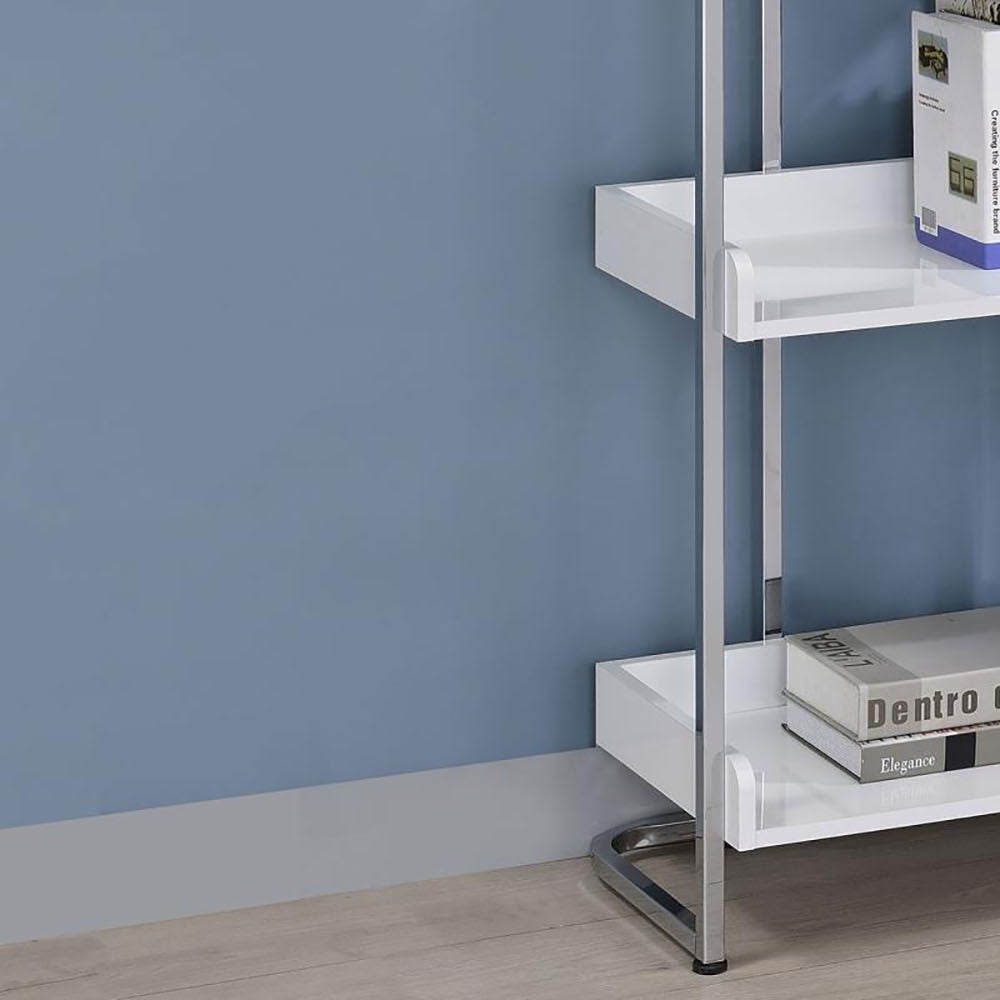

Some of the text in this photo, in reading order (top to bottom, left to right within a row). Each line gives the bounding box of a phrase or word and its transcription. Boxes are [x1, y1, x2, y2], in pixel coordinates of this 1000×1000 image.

[990, 109, 1000, 234] Creating the furniture brand
[868, 690, 978, 729] Dentro
[880, 755, 936, 775] Elegance
